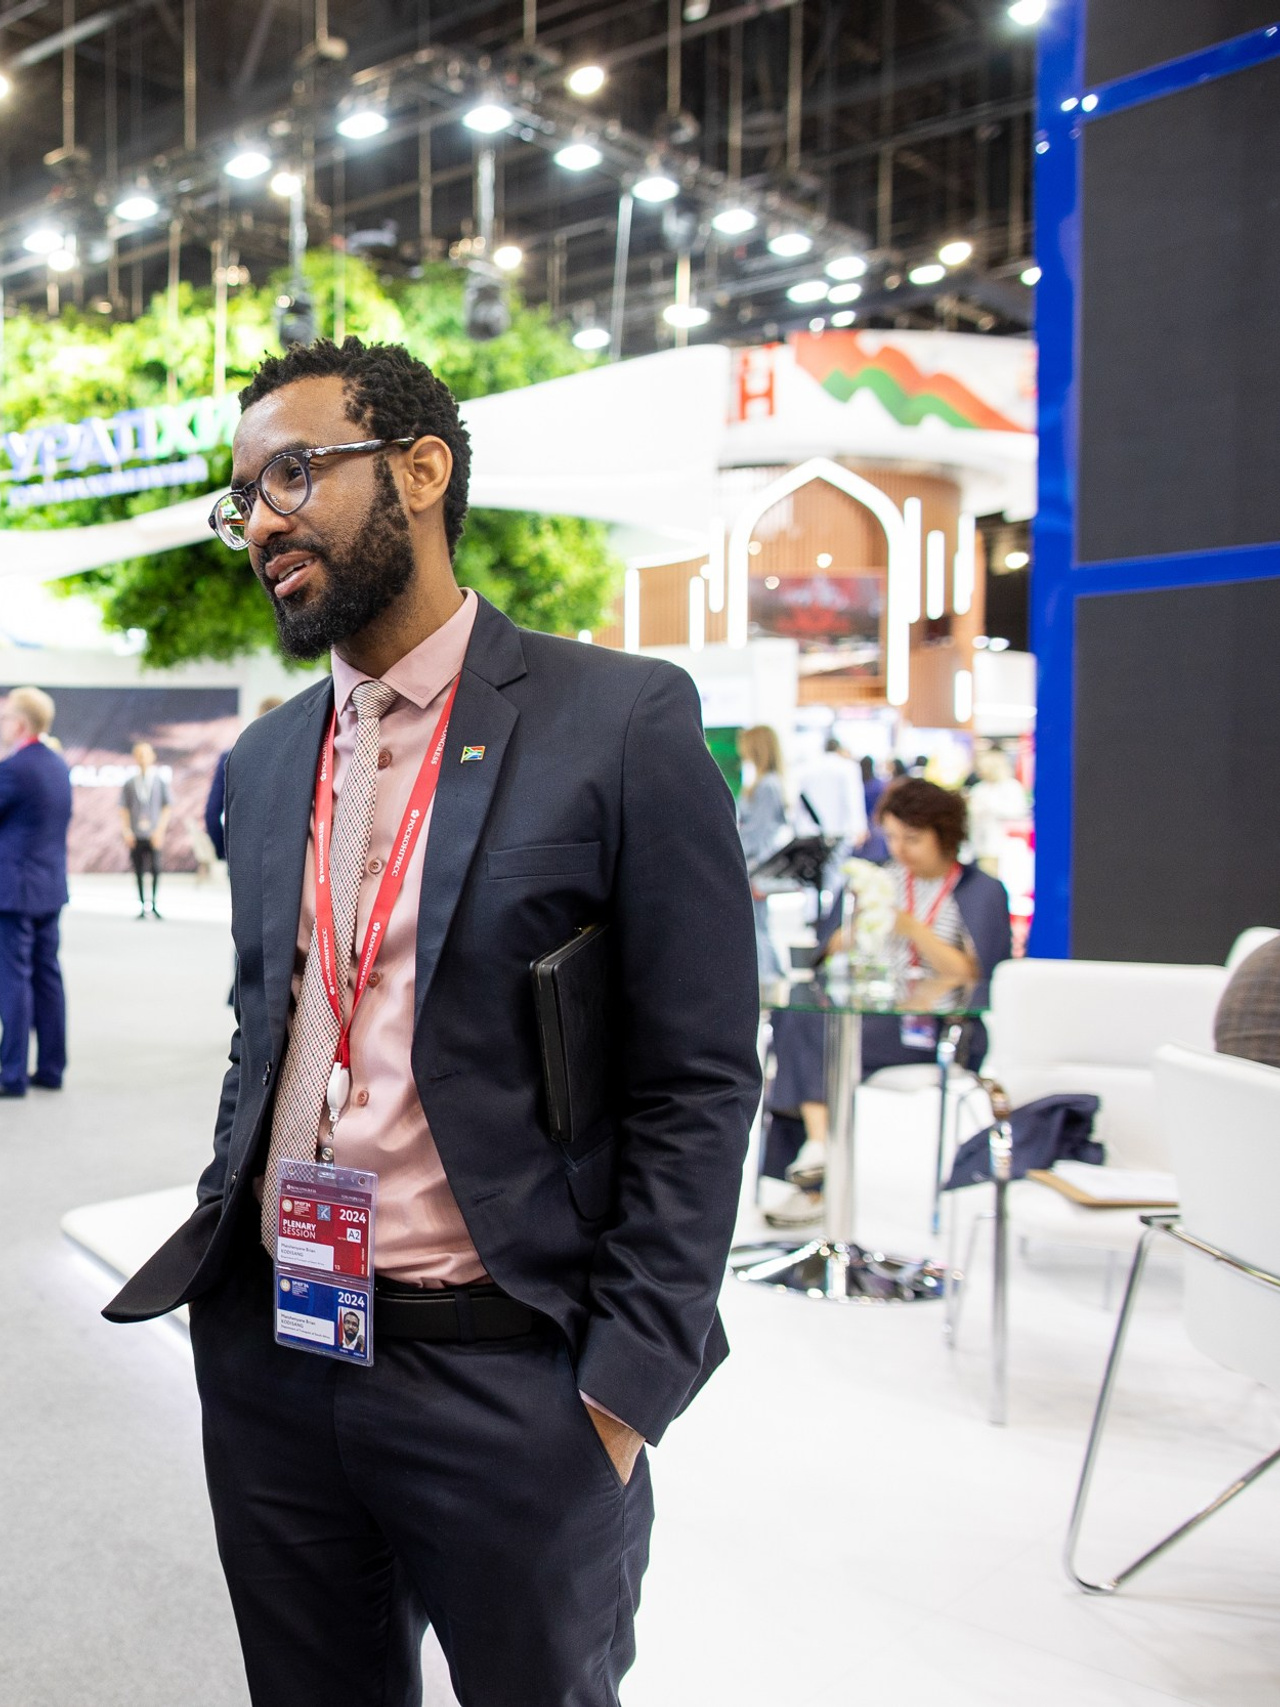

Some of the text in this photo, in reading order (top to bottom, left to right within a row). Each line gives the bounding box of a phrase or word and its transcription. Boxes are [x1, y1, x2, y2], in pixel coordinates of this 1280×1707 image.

[391, 818, 417, 877] РОСКОНГРЕСС
[339, 1208, 367, 1223] 2024
[282, 1219, 317, 1231] PLENARY
[282, 1226, 316, 1239] SESSION
[348, 1230, 360, 1241] A2
[337, 1291, 366, 1308] 2024
